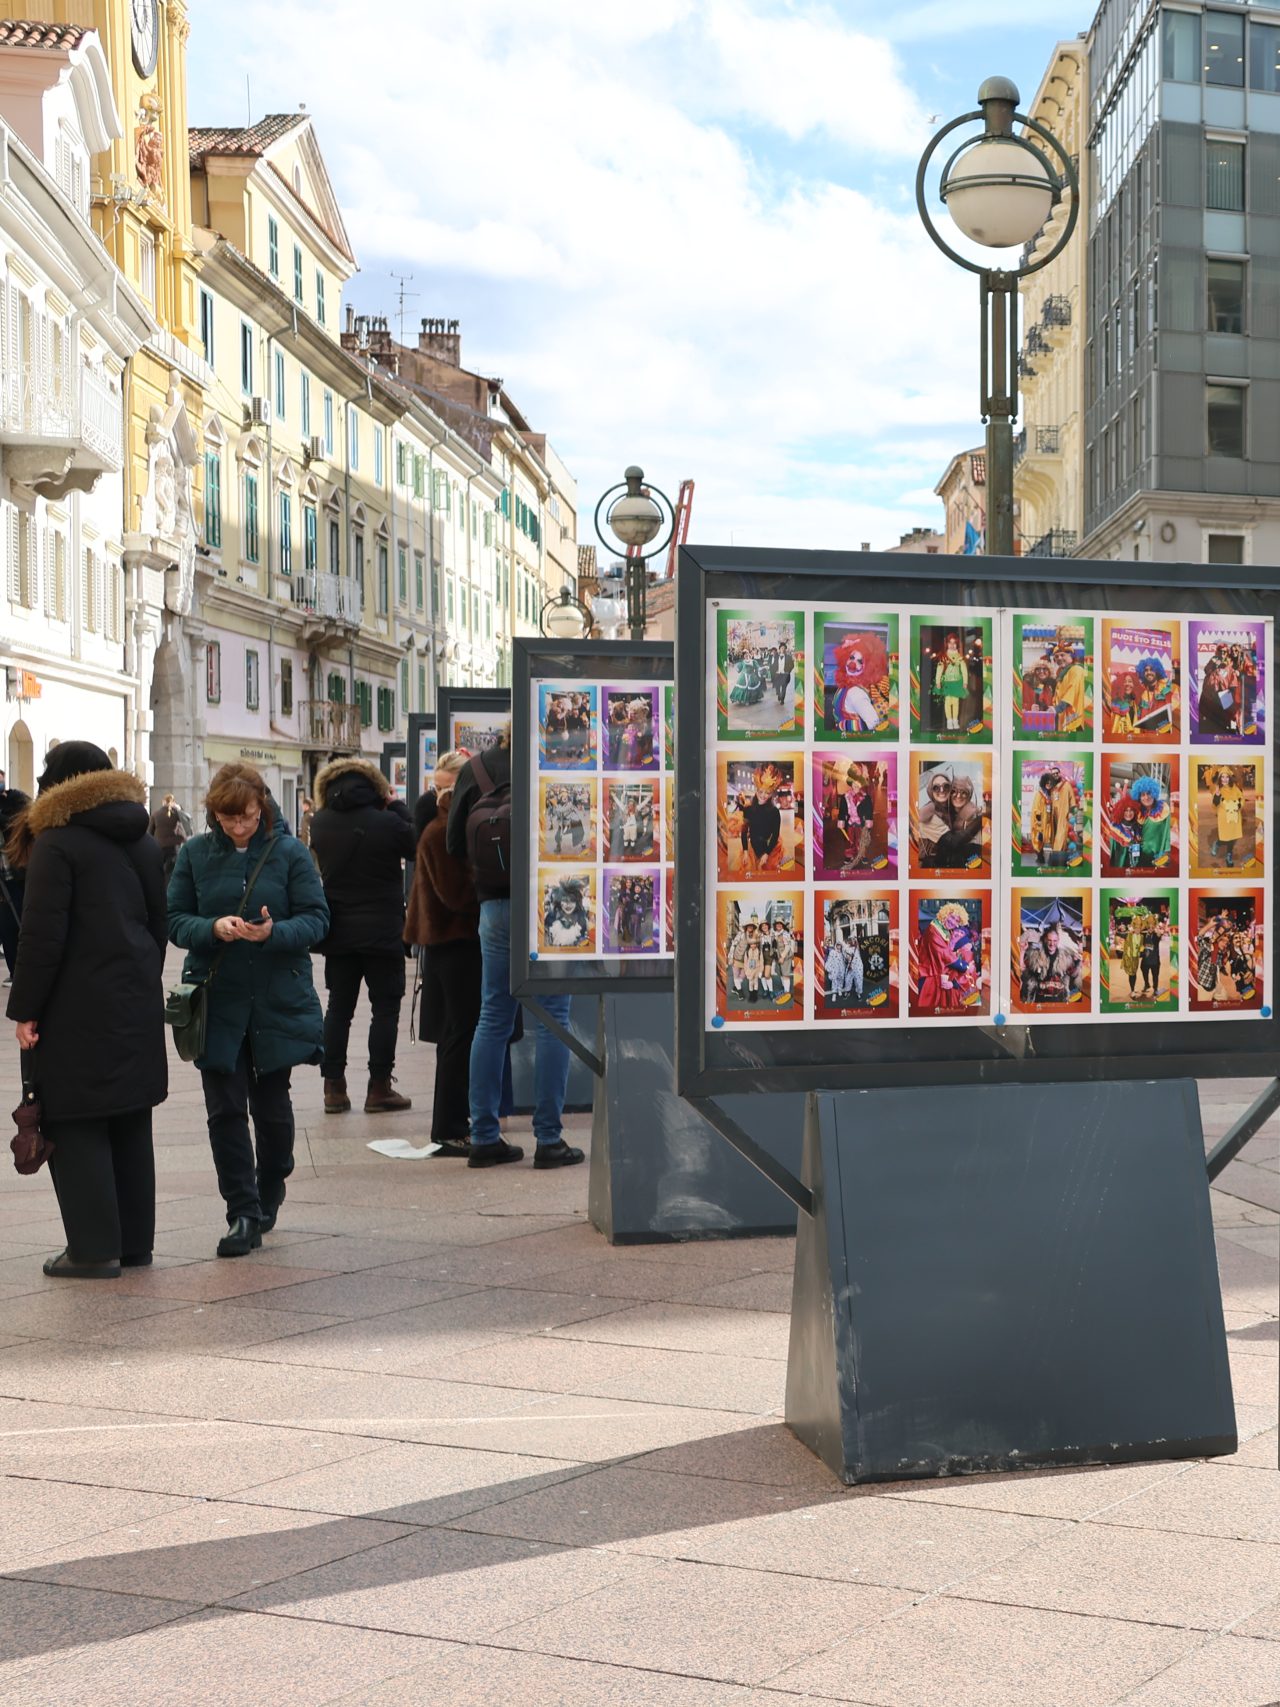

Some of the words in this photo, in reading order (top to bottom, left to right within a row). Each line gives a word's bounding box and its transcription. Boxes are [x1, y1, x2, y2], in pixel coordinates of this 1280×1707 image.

[1112, 632, 1133, 643] BUDI
[1134, 633, 1150, 645] ŠTO
[1150, 636, 1171, 648] ŽELIŠ
